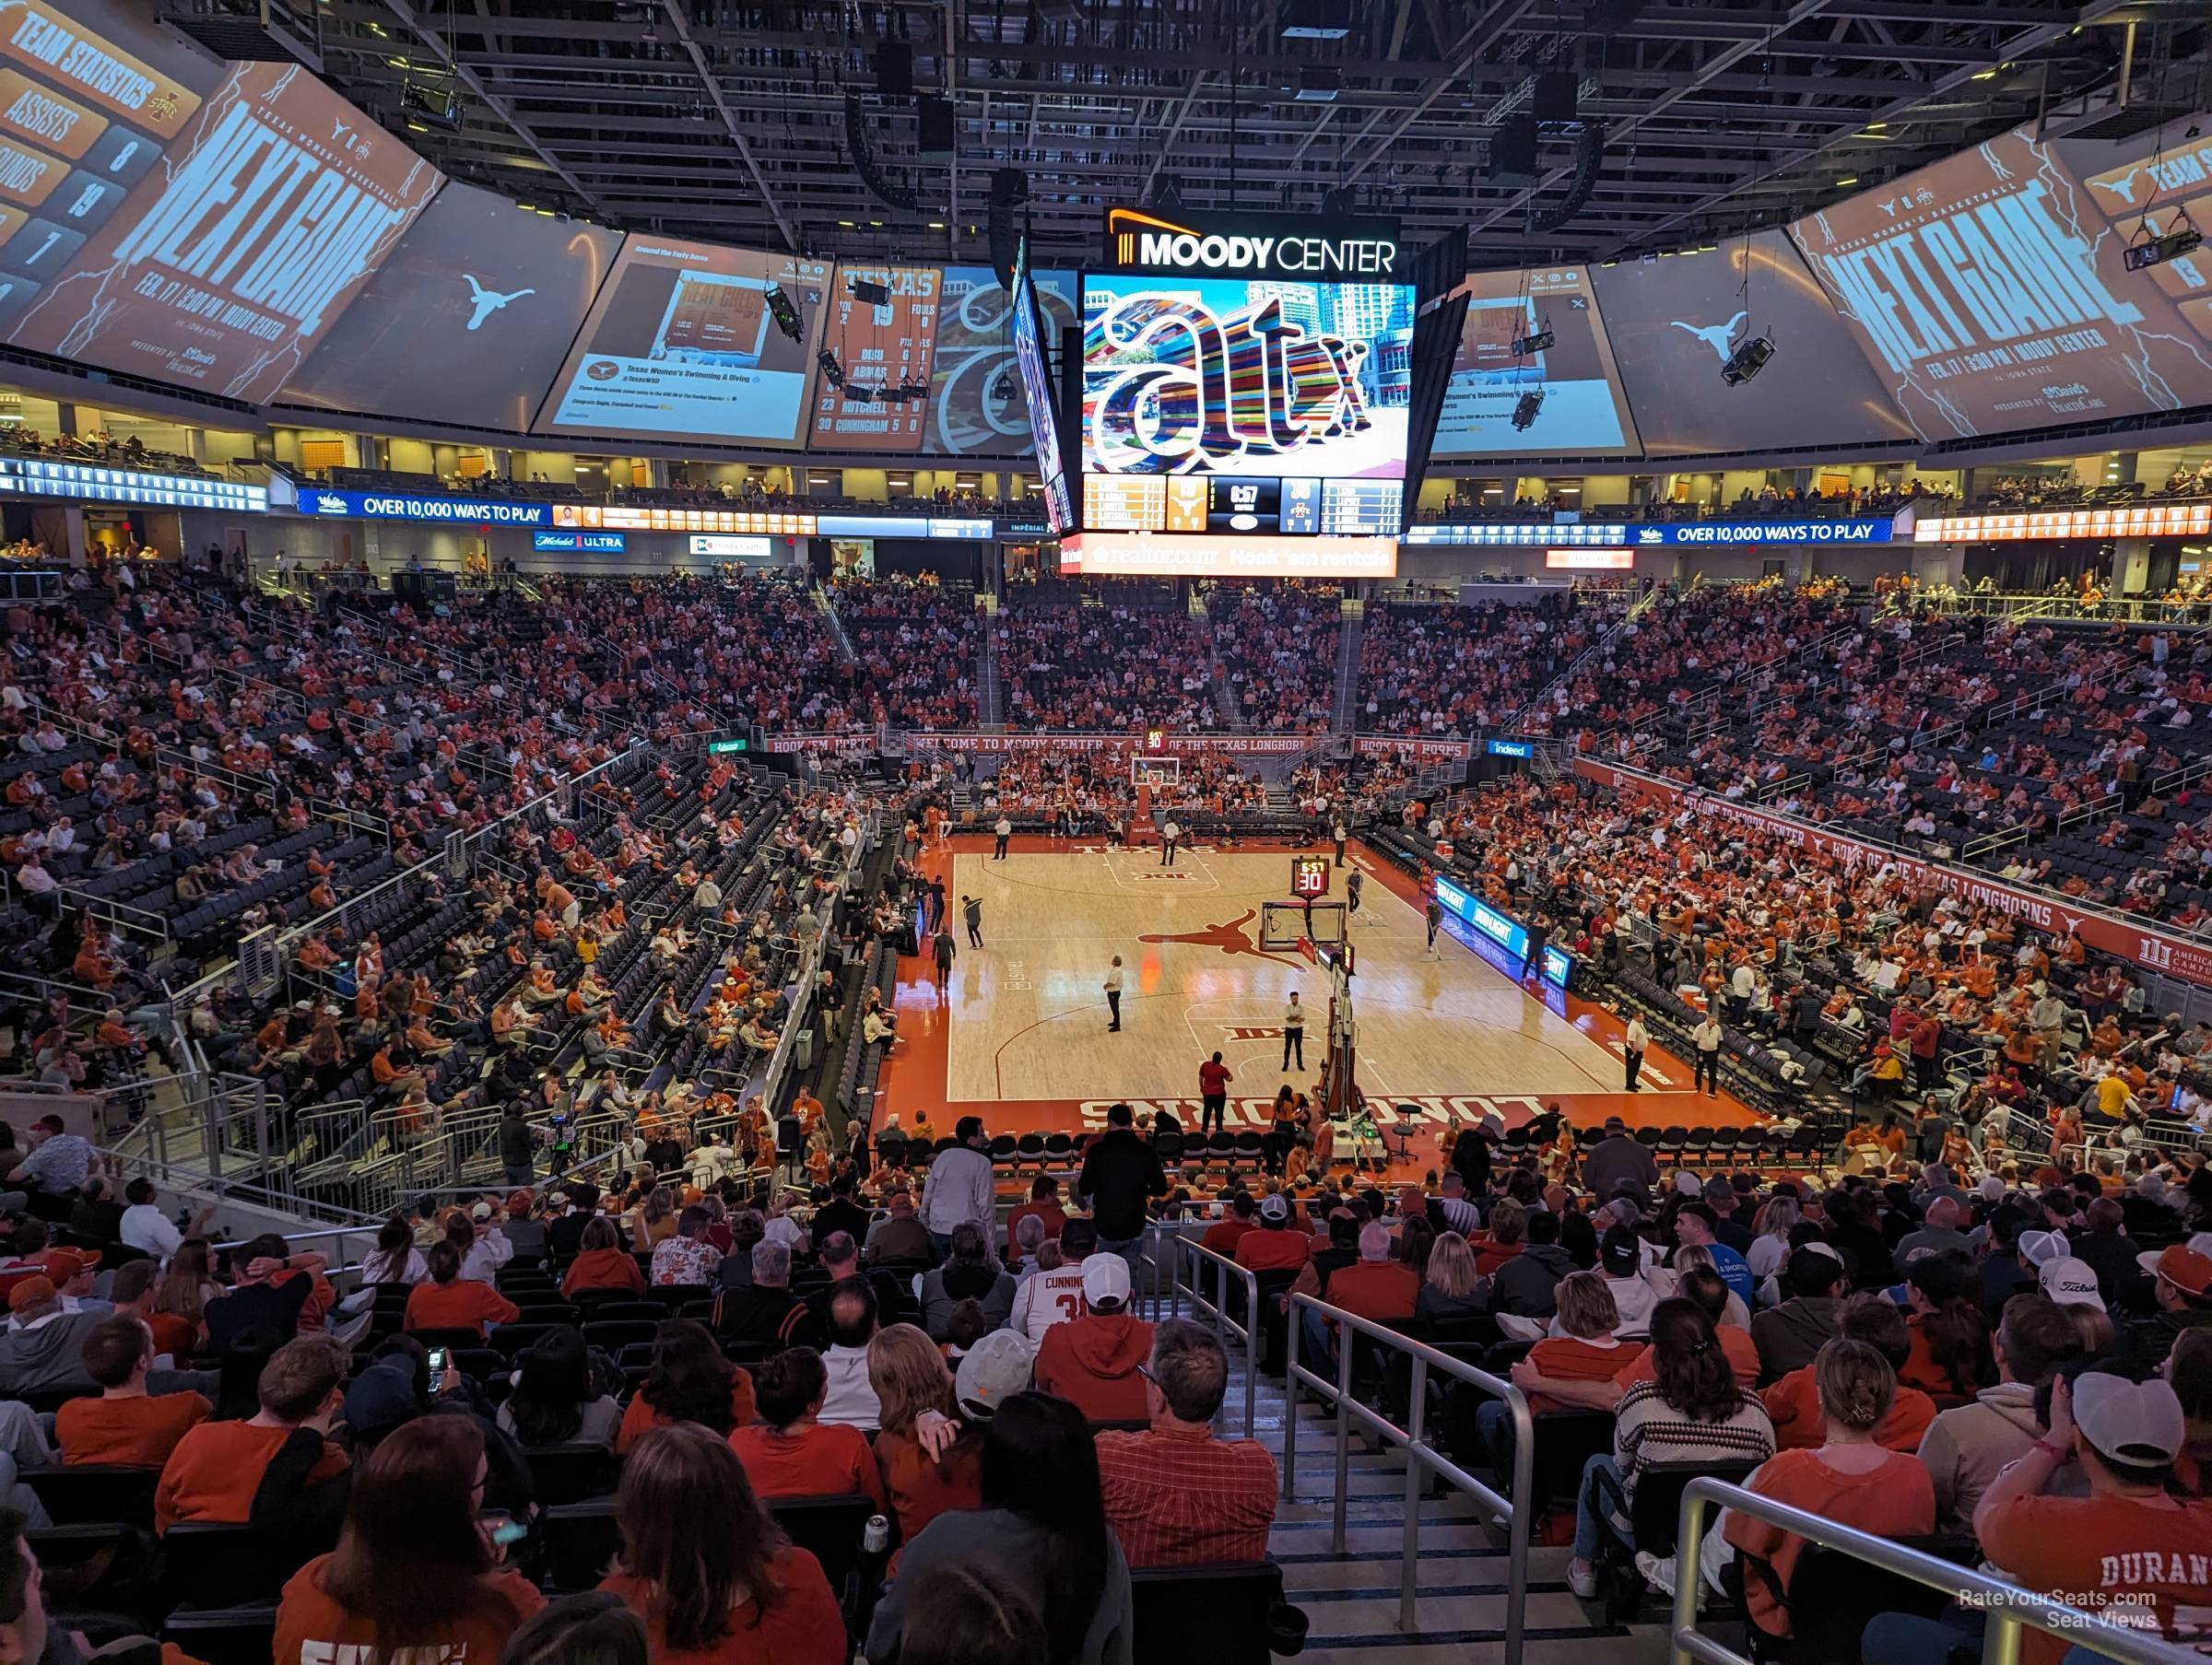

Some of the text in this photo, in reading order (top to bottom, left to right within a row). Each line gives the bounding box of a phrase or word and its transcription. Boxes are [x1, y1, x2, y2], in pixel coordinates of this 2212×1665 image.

[10, 9, 157, 111] TEAM STATISTICS
[4, 89, 79, 143] ASSISTS
[110, 141, 138, 172] 8
[256, 106, 399, 206] TEXAS WOMEN'S BASKETBALL
[2146, 153, 2207, 192] TEAM
[67, 182, 105, 217] 19
[112, 100, 407, 337] NEXT GAME
[1834, 183, 2017, 253] TEXAS WOMEN'S BASKETBALL
[1140, 233, 1395, 273] MOODY CENTER
[1823, 179, 2147, 372] NEXT GAME
[133, 271, 165, 299] FEB.
[157, 280, 182, 302] 17
[912, 304, 935, 315] FOULS
[1926, 329, 2109, 380] FEB. 17 3:00 PM MOODY CENTER
[627, 365, 649, 374] Texas
[650, 366, 684, 377] Women's
[684, 369, 721, 381] Swimming
[728, 375, 750, 383] Diving
[821, 398, 835, 411] 23
[841, 401, 887, 414] MITCHELL
[912, 401, 920, 412] 0
[1477, 391, 1514, 400] Swimming
[818, 417, 917, 432] 30 CUNNINGHAM 5 0
[364, 498, 541, 522] OVER 10,000 WAYS TO PLAY
[535, 535, 623, 547] Michelob ULTRA
[1677, 524, 1874, 543] OVER 10,000 WAYS TO PLAY
[1230, 546, 1278, 565] Hook
[1322, 547, 1389, 567] rentals
[774, 742, 804, 753] HOOK
[916, 739, 1104, 750] WELCOME TO MOODY CENTER
[1147, 738, 1161, 748] 30
[1169, 740, 1304, 750] OF THE TEXAS LONGHOR
[1360, 741, 1392, 752] HOOK
[1422, 745, 1463, 756] HORNS
[1494, 742, 1524, 756] indeed
[1722, 808, 1734, 818] TO
[1735, 811, 1766, 830] MOODY
[1767, 820, 1805, 847] CENTER
[1074, 846, 1217, 854] TEXAS
[1301, 862, 1324, 873] 6:57
[1300, 873, 1320, 890] 30
[1867, 852, 1882, 868] OF
[1963, 881, 2052, 926] LONGHORNS
[1488, 916, 1510, 941] LIGHT
[2060, 1281, 2096, 1292] Titleist
[2101, 1552, 2212, 1587] DURAN
